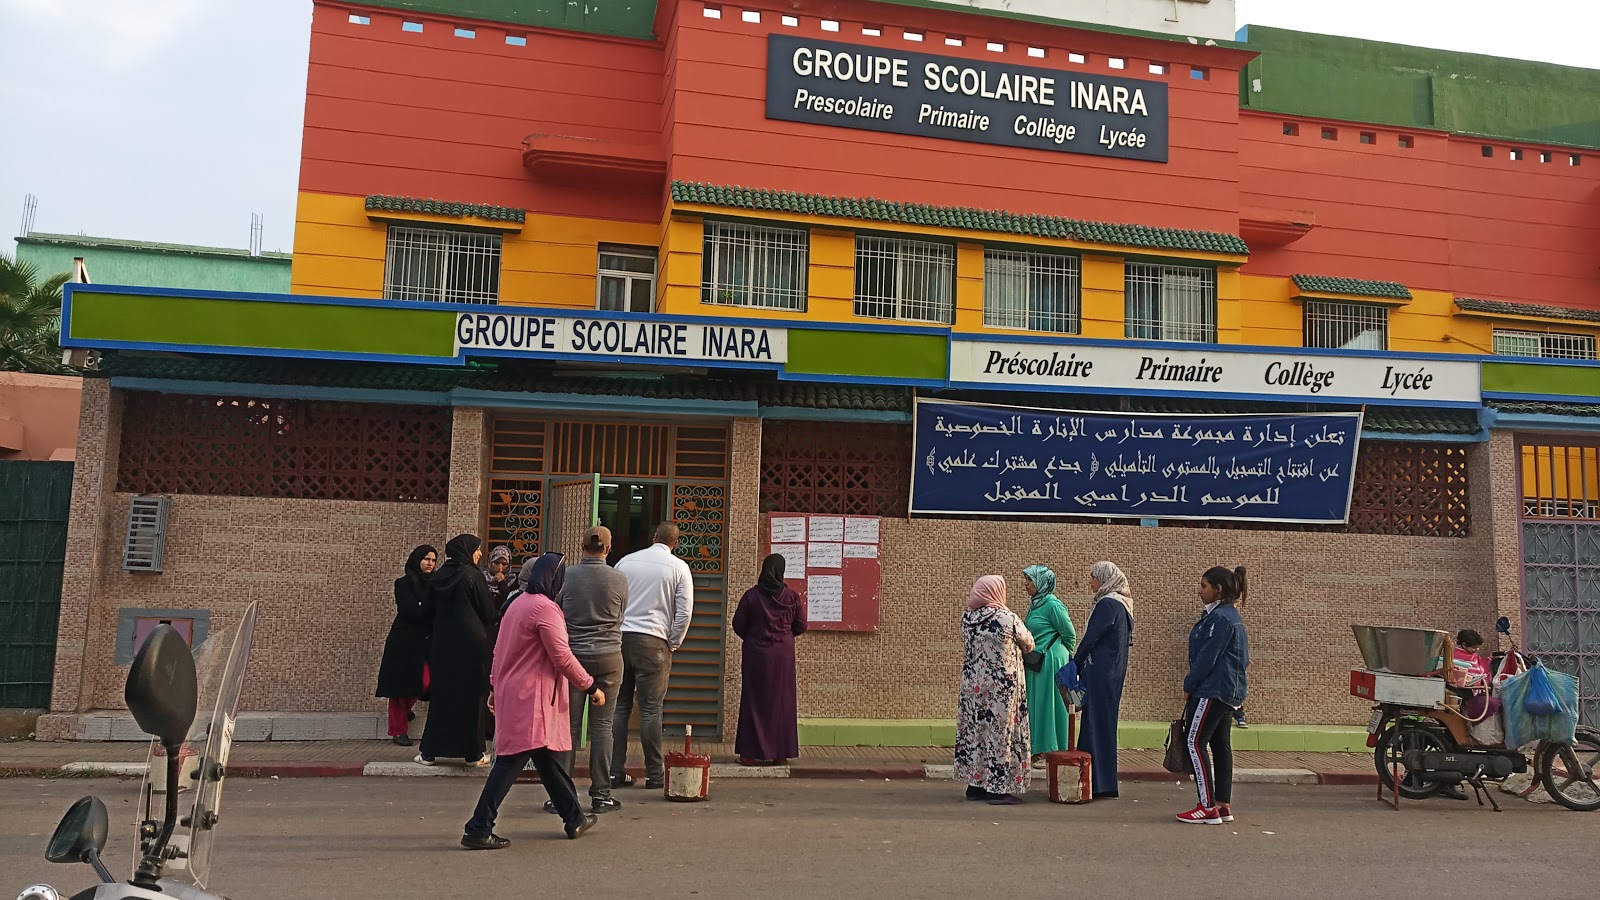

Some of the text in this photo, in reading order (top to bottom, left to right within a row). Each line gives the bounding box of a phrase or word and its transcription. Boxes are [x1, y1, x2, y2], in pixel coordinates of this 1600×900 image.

[793, 48, 1149, 116] GROUPE SCOLAIRE INARA
[794, 89, 1145, 149] Prescolaire Primaire Collège Lycée
[457, 313, 772, 360] GROUPE SCOLAIRE INARA
[983, 351, 1432, 395] Préscolaire Primaire Collège Lycée
[936, 416, 1345, 448] تعلن إدارة مجموعة مدارس الإنارة الخصوصية
[938, 449, 977, 473] علمي
[982, 450, 1037, 474] مشترك
[1105, 450, 1156, 478] التأهيلي
[1162, 456, 1219, 479] بالمستوى
[1226, 457, 1271, 479] التسجيل
[1277, 458, 1313, 483] افتتاح
[1319, 464, 1338, 481] عن
[984, 481, 1279, 509] للموسم الدراسي المقبل
